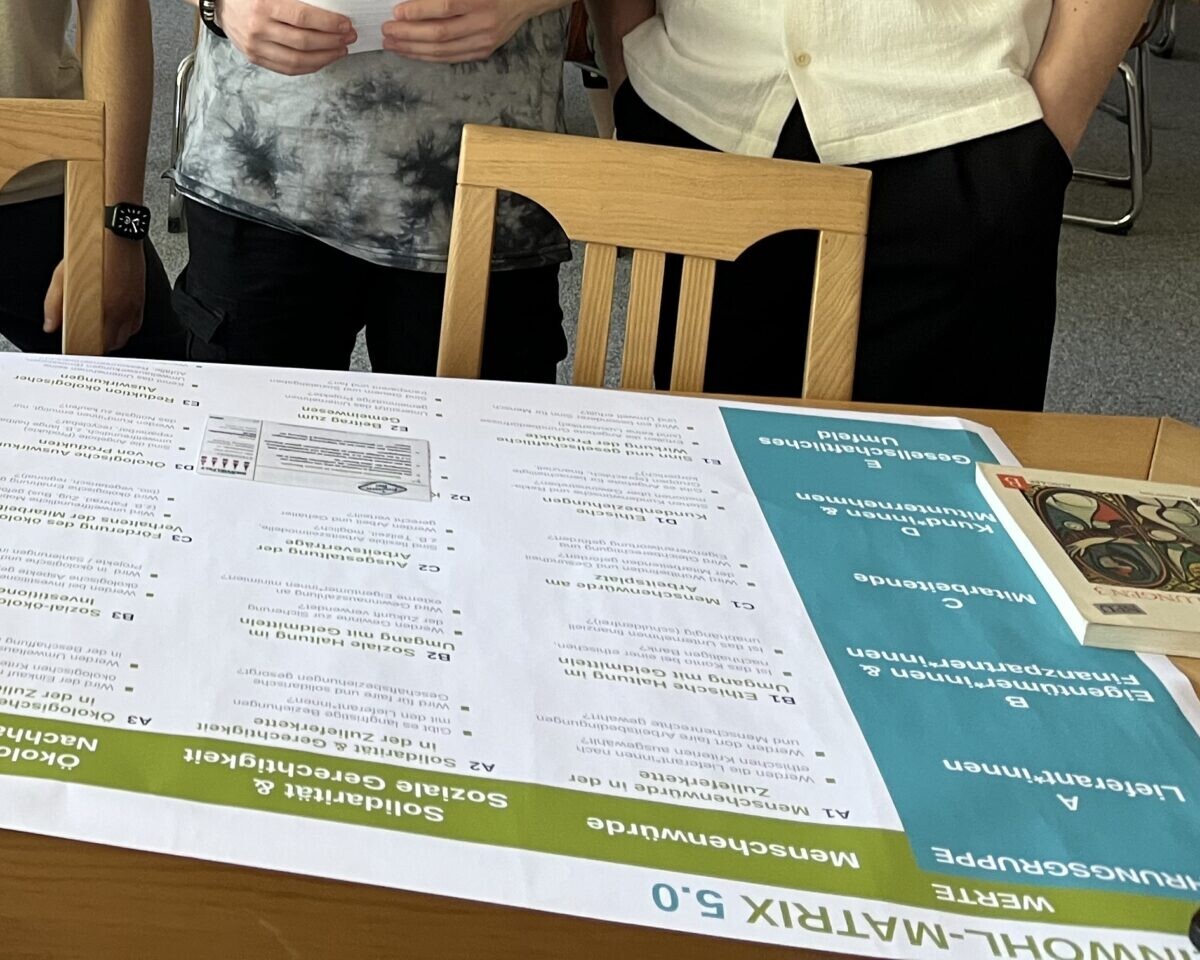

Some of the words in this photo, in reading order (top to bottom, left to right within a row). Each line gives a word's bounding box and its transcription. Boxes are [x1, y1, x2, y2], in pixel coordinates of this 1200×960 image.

[16, 376, 100, 391] ökologischer
[61, 374, 156, 392] Auswirkungen
[106, 388, 174, 403] Reduktion
[302, 406, 400, 423] Gemeinwesen
[332, 417, 381, 429] Beitrag
[39, 439, 112, 453] Produkten
[497, 437, 620, 453] gesellschaftliche
[526, 434, 591, 444] Produkte
[817, 431, 898, 446] Umfeld
[625, 443, 687, 454] Wirkung
[759, 437, 971, 464] Gesellschaftliches
[75, 453, 165, 468] Ökologische
[865, 459, 881, 468] E
[543, 497, 707, 520] Kundenbeziehungen
[577, 509, 646, 521] Ethische
[796, 493, 997, 523] Mitunternehmen
[820, 506, 837, 515] &
[48, 520, 74, 528] des
[80, 523, 161, 539] Förderung
[102, 517, 182, 533] Verhaltens
[901, 527, 920, 536] D
[257, 545, 282, 553] der
[286, 539, 411, 559] Arbeitsverträge
[289, 547, 407, 568] Ausgestaltung
[419, 564, 440, 572] C2
[596, 575, 696, 592] Arbeitsplatz
[854, 573, 1037, 604] Mitarbeitende
[577, 583, 720, 605] Menschenwürde
[731, 601, 754, 610] C1
[942, 598, 963, 608] C
[112, 612, 134, 621] B3
[240, 618, 340, 635] Geldmitteln
[249, 629, 268, 638] im
[348, 630, 373, 638] mit
[276, 631, 344, 647] Haltung
[381, 633, 455, 651] Umgang
[351, 641, 415, 657] Soziale
[428, 652, 450, 661] B2
[559, 657, 666, 677] Geldmitteln
[565, 669, 586, 679] im
[859, 664, 880, 676] &
[593, 671, 667, 688] Haltung
[673, 672, 701, 680] mit
[708, 674, 789, 693] Umgang
[42, 692, 72, 702] der
[674, 683, 757, 700] Ethische
[79, 696, 95, 706] in
[770, 695, 795, 704] B1
[1005, 696, 1029, 708] B
[128, 716, 151, 725] A3
[197, 723, 326, 748] Gerechtigkeit
[254, 718, 374, 742] Zulieferkette
[334, 742, 347, 751] &
[381, 736, 412, 746] der
[420, 741, 436, 751] in
[354, 745, 456, 767] Solidarität
[184, 748, 385, 790] Gerechtigkeit
[470, 761, 495, 772] A2
[253, 778, 274, 795] &
[569, 775, 601, 787] der
[609, 780, 626, 791] in
[640, 771, 769, 797] Zulieferkette
[396, 780, 507, 808] Soziale
[635, 784, 809, 816] Menschenwürde
[284, 783, 443, 822] Solidarität
[1056, 793, 1079, 811] A
[823, 809, 849, 819] A1
[587, 817, 860, 868] Menschenwürde
[652, 883, 725, 920] 5.0
[932, 884, 1055, 913] WERTE
